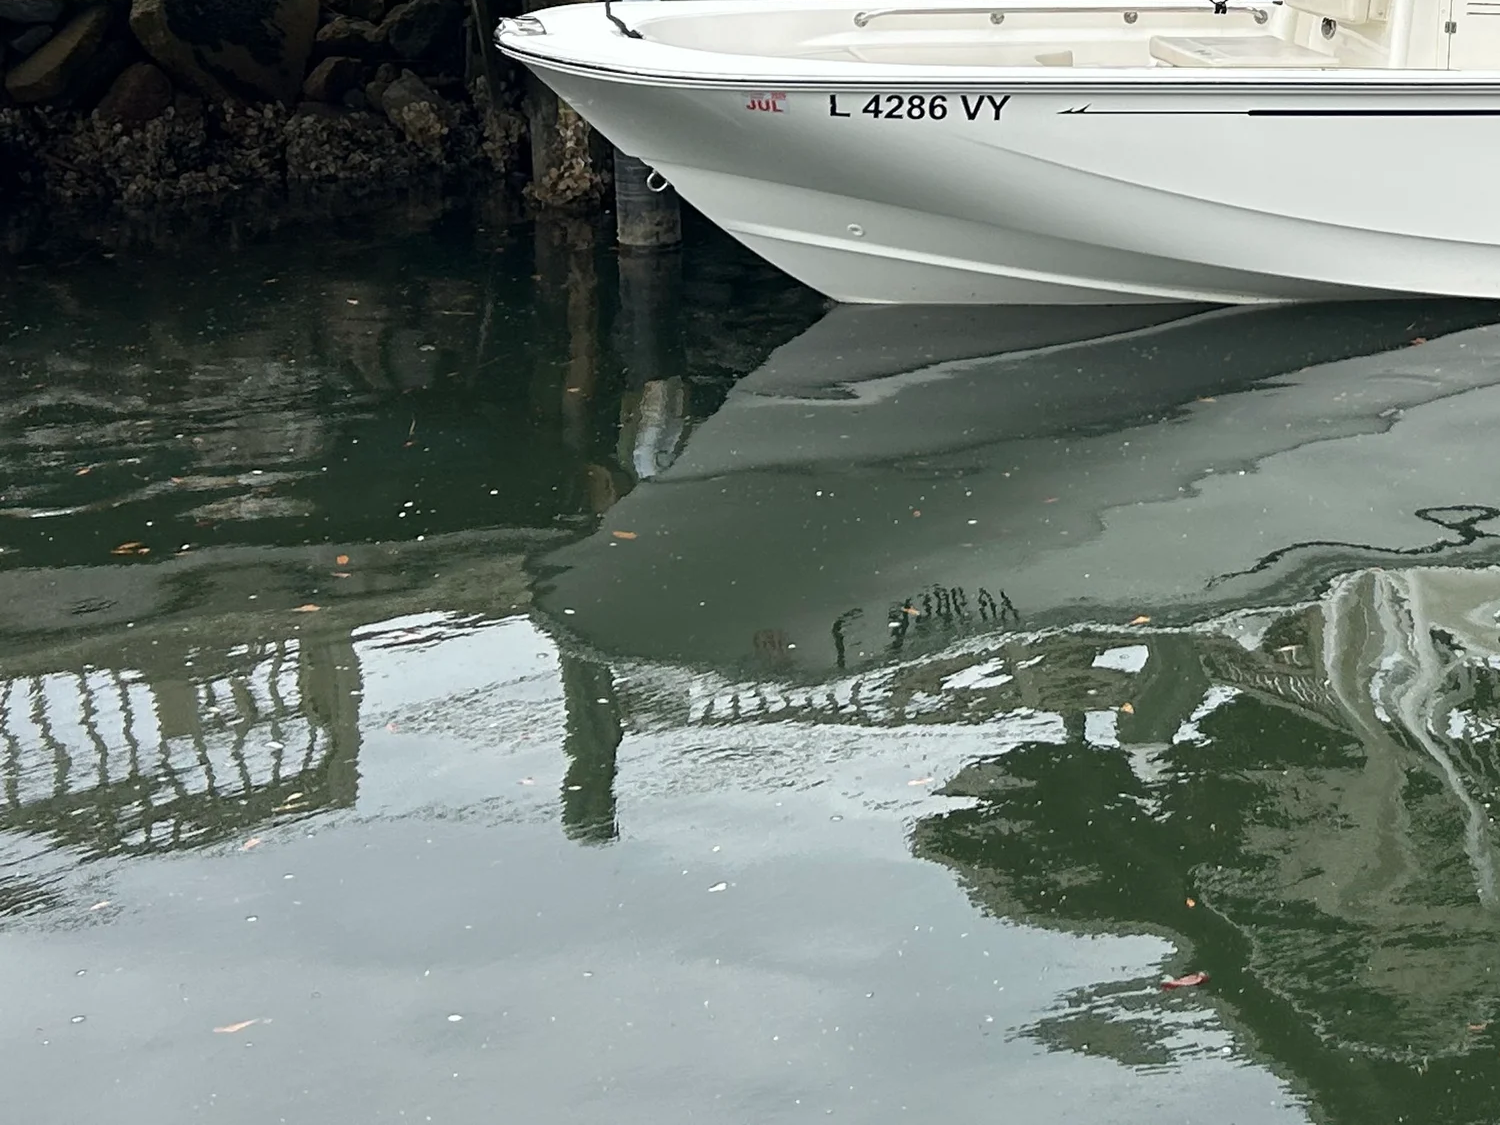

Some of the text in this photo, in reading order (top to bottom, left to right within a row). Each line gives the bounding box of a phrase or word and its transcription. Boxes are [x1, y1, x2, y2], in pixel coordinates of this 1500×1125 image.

[745, 99, 784, 113] JUL
[861, 94, 948, 121] 4286
[959, 94, 1012, 121] VY
